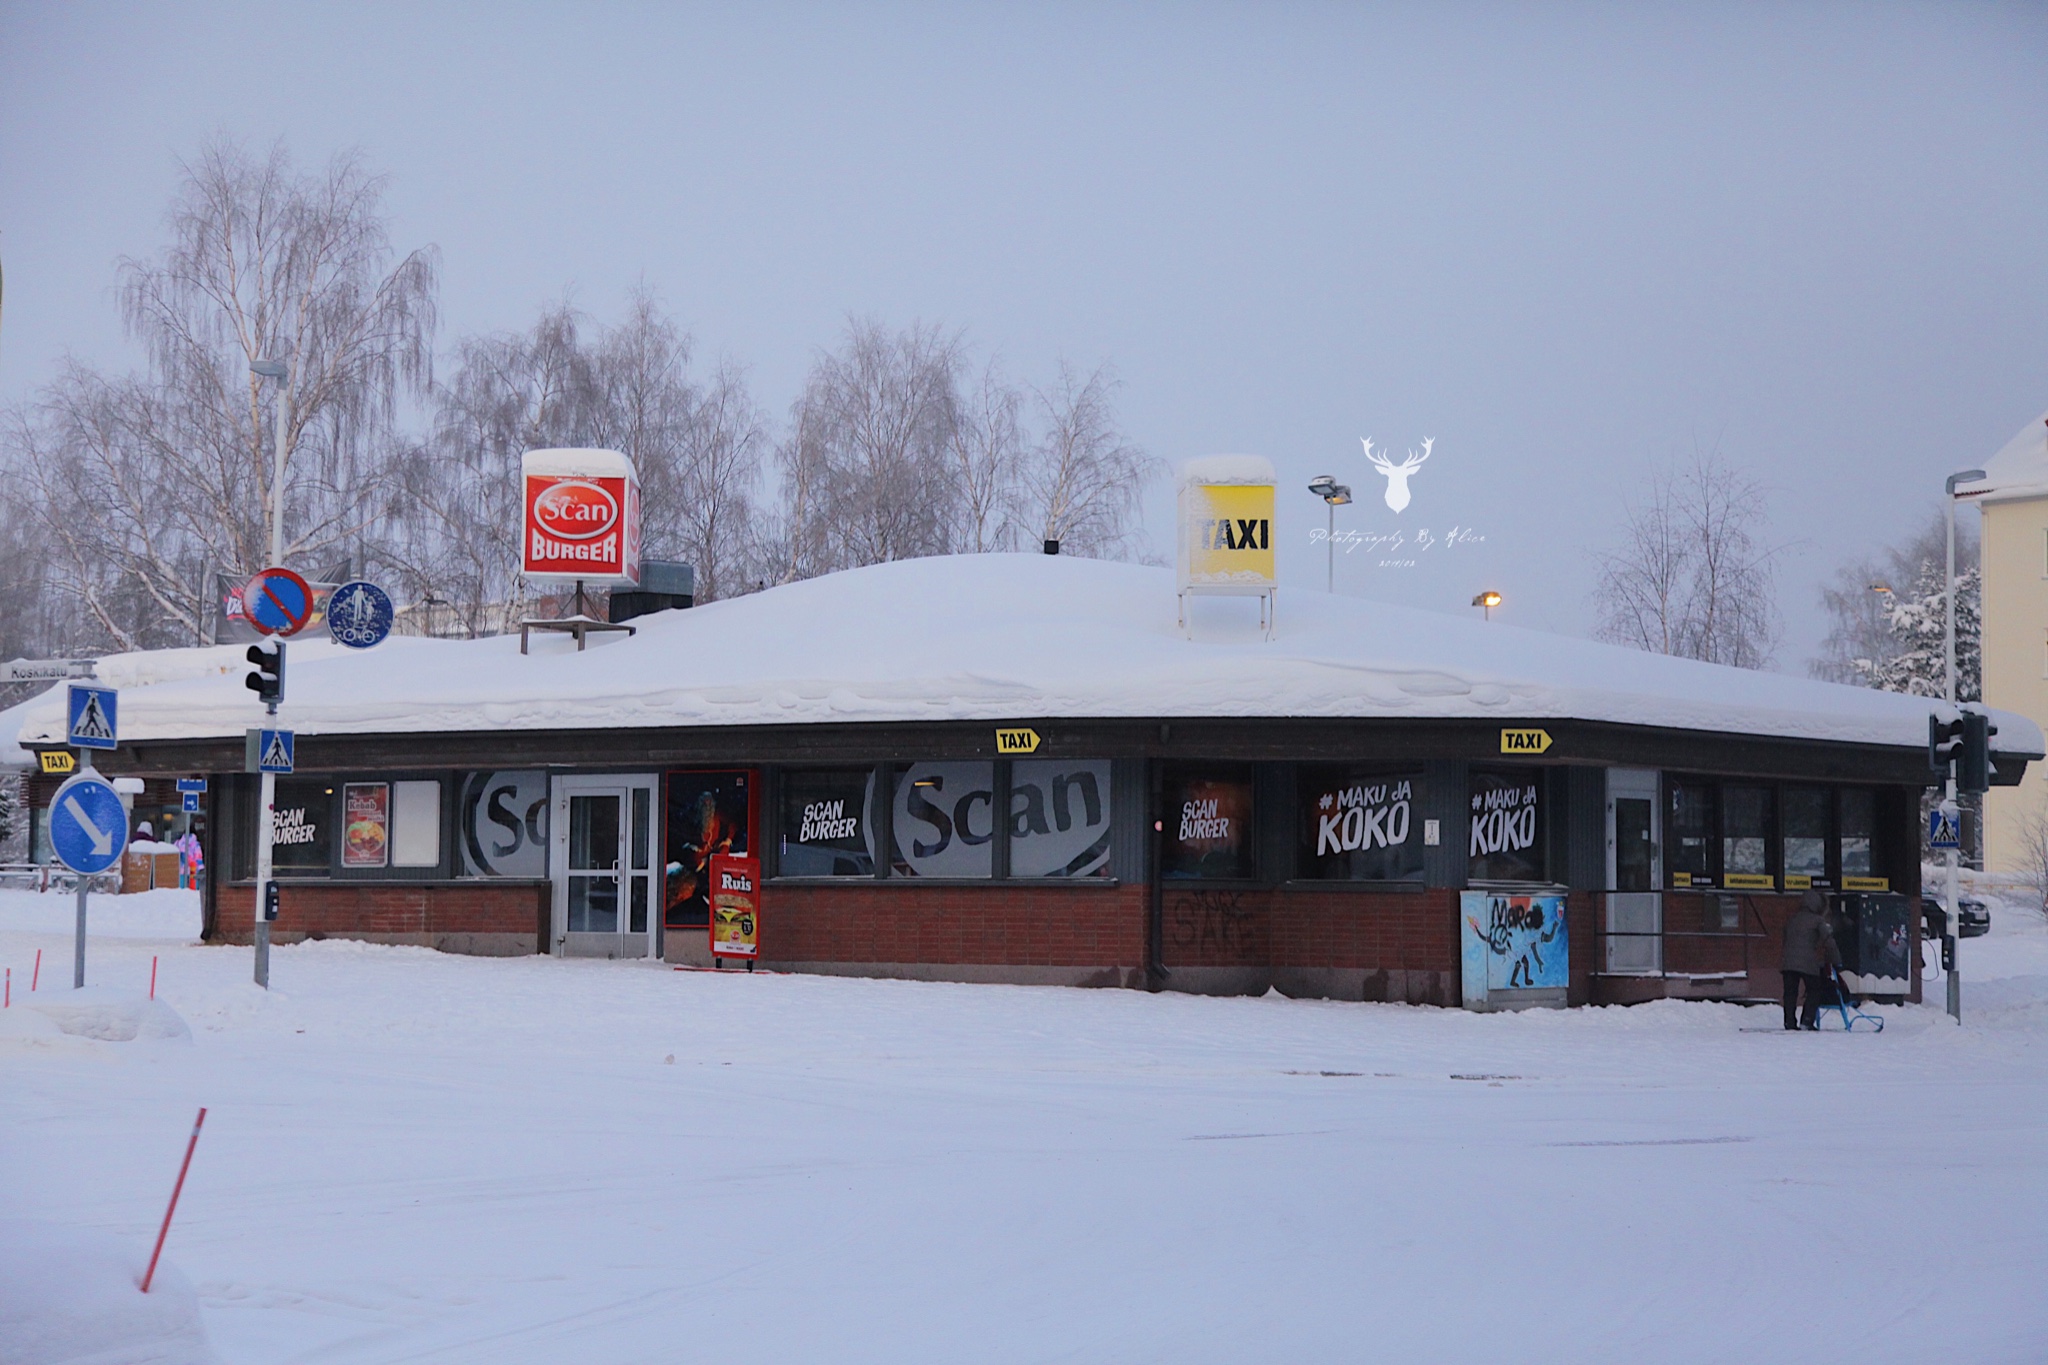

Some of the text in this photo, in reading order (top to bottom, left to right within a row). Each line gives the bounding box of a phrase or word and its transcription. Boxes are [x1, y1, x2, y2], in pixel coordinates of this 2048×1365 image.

[544, 496, 608, 521] Scan
[532, 528, 617, 563] BURGER
[1196, 518, 1270, 550] TAXI
[11, 666, 67, 679] Koskikatu
[999, 732, 1032, 749] TAXI
[1504, 733, 1542, 749] TAXI
[44, 755, 69, 769] TAXI
[348, 800, 376, 811] Kebab
[1336, 784, 1387, 811] MAKU
[1391, 780, 1412, 801] JA
[1484, 788, 1520, 812] MAKU
[1522, 785, 1537, 805] JA
[803, 799, 844, 823] SCAN
[907, 770, 1101, 858] Scan
[1182, 799, 1218, 820] SCAN
[800, 818, 857, 842] BURGER
[1179, 818, 1229, 840] BURGER
[1317, 800, 1410, 856] KOKO
[1470, 805, 1536, 857] KOKO
[721, 873, 752, 892] Ruis
